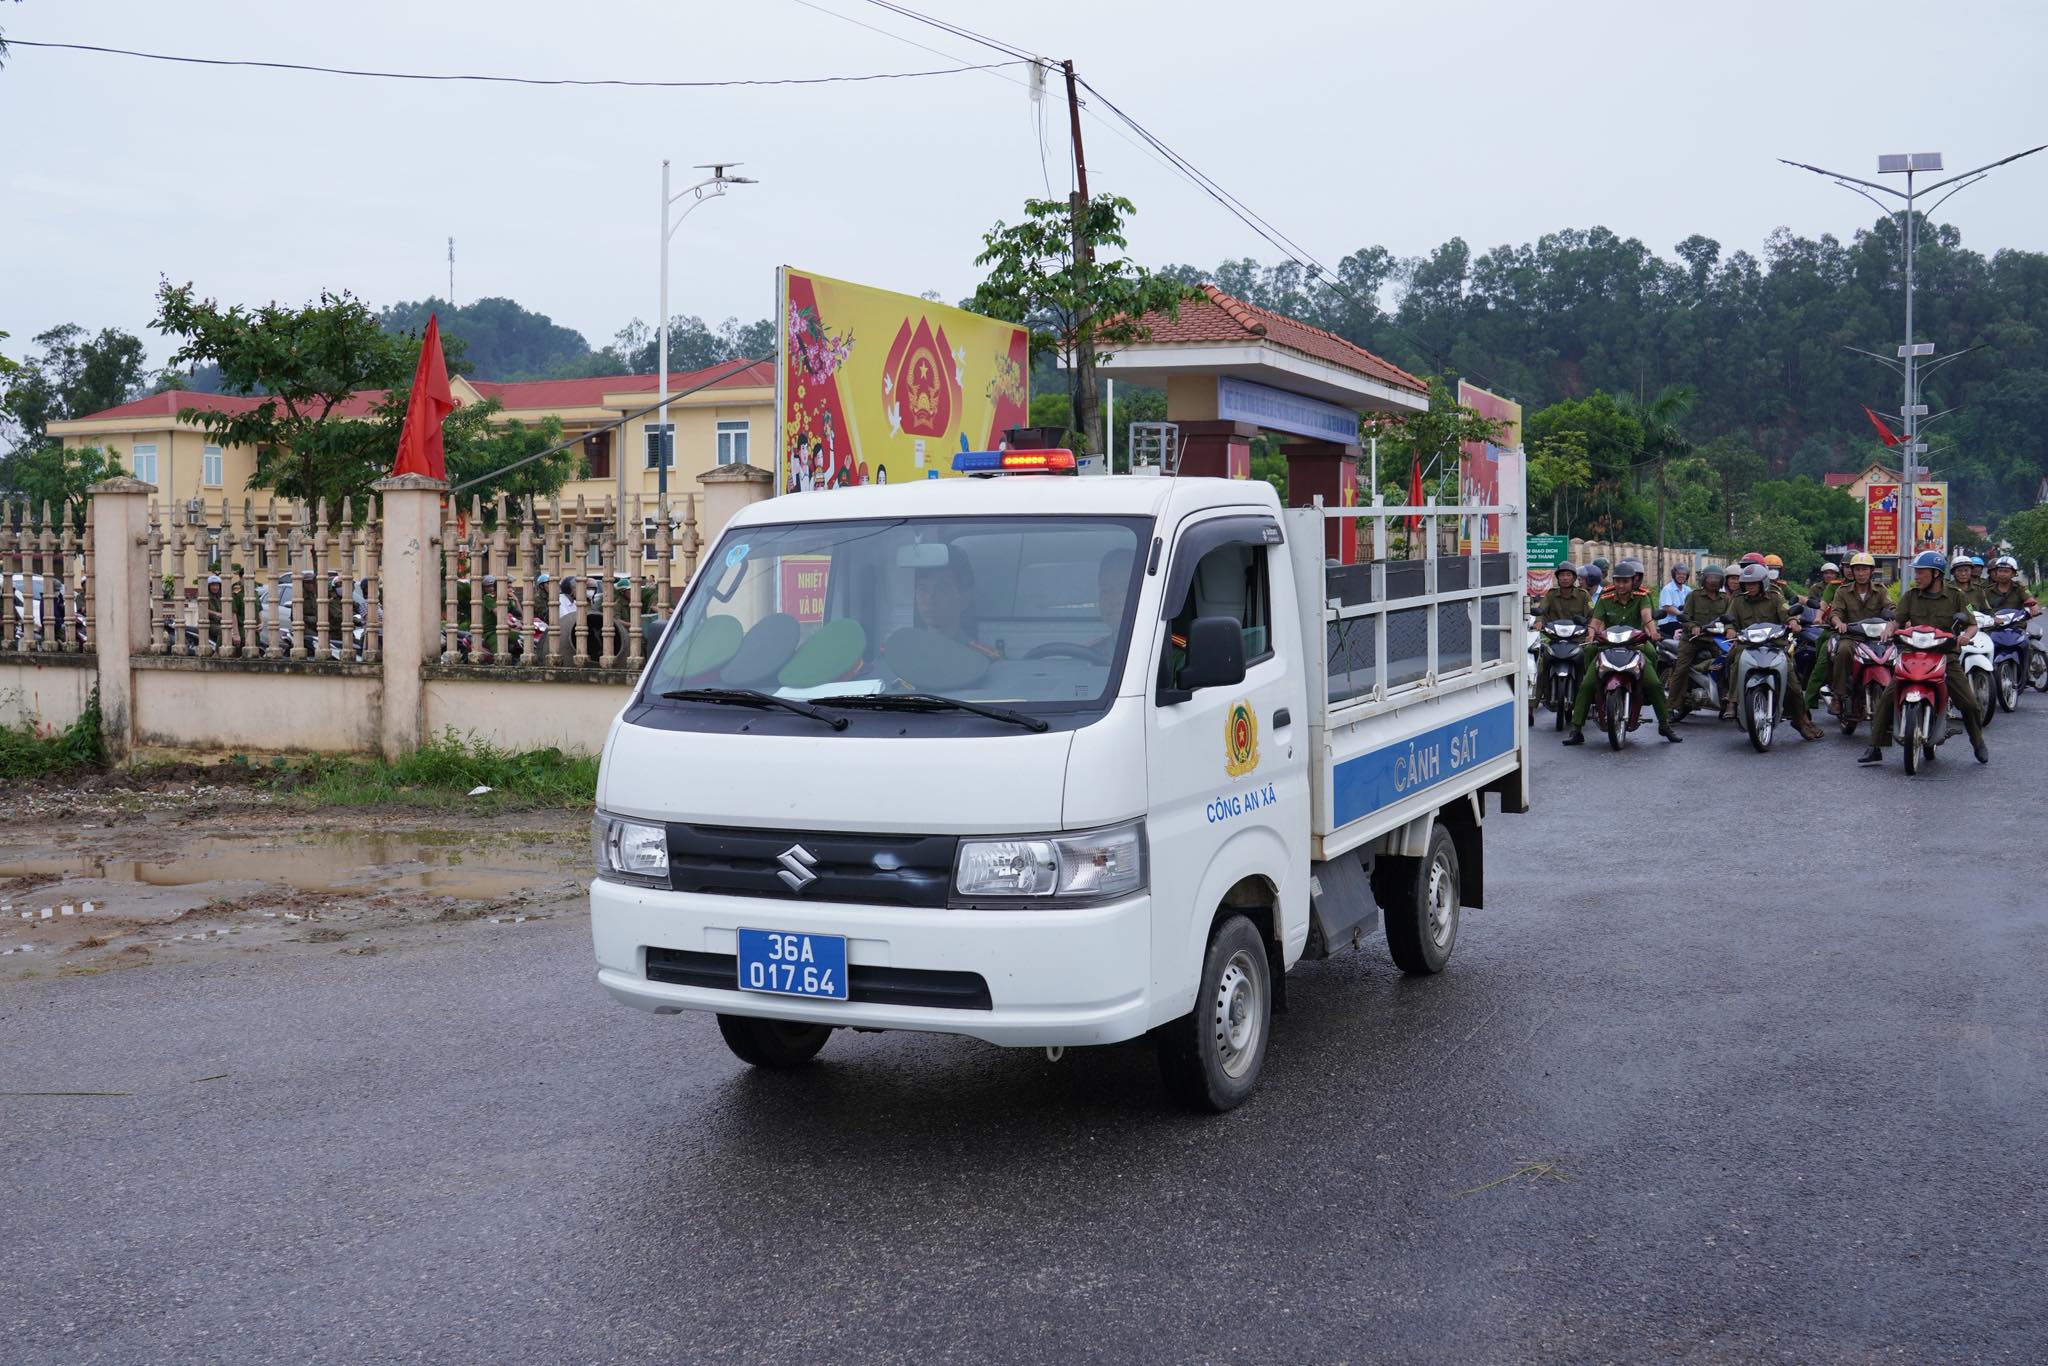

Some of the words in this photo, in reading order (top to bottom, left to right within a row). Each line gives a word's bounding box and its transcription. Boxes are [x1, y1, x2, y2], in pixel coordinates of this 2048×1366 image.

[1394, 742, 1440, 792] CẢNH
[1450, 725, 1478, 769] SÁT
[1206, 796, 1241, 823] CÔNG
[1244, 790, 1260, 813] AN
[1260, 782, 1277, 807] XÃ
[768, 933, 815, 963] 36A
[750, 961, 835, 995] 017.64
